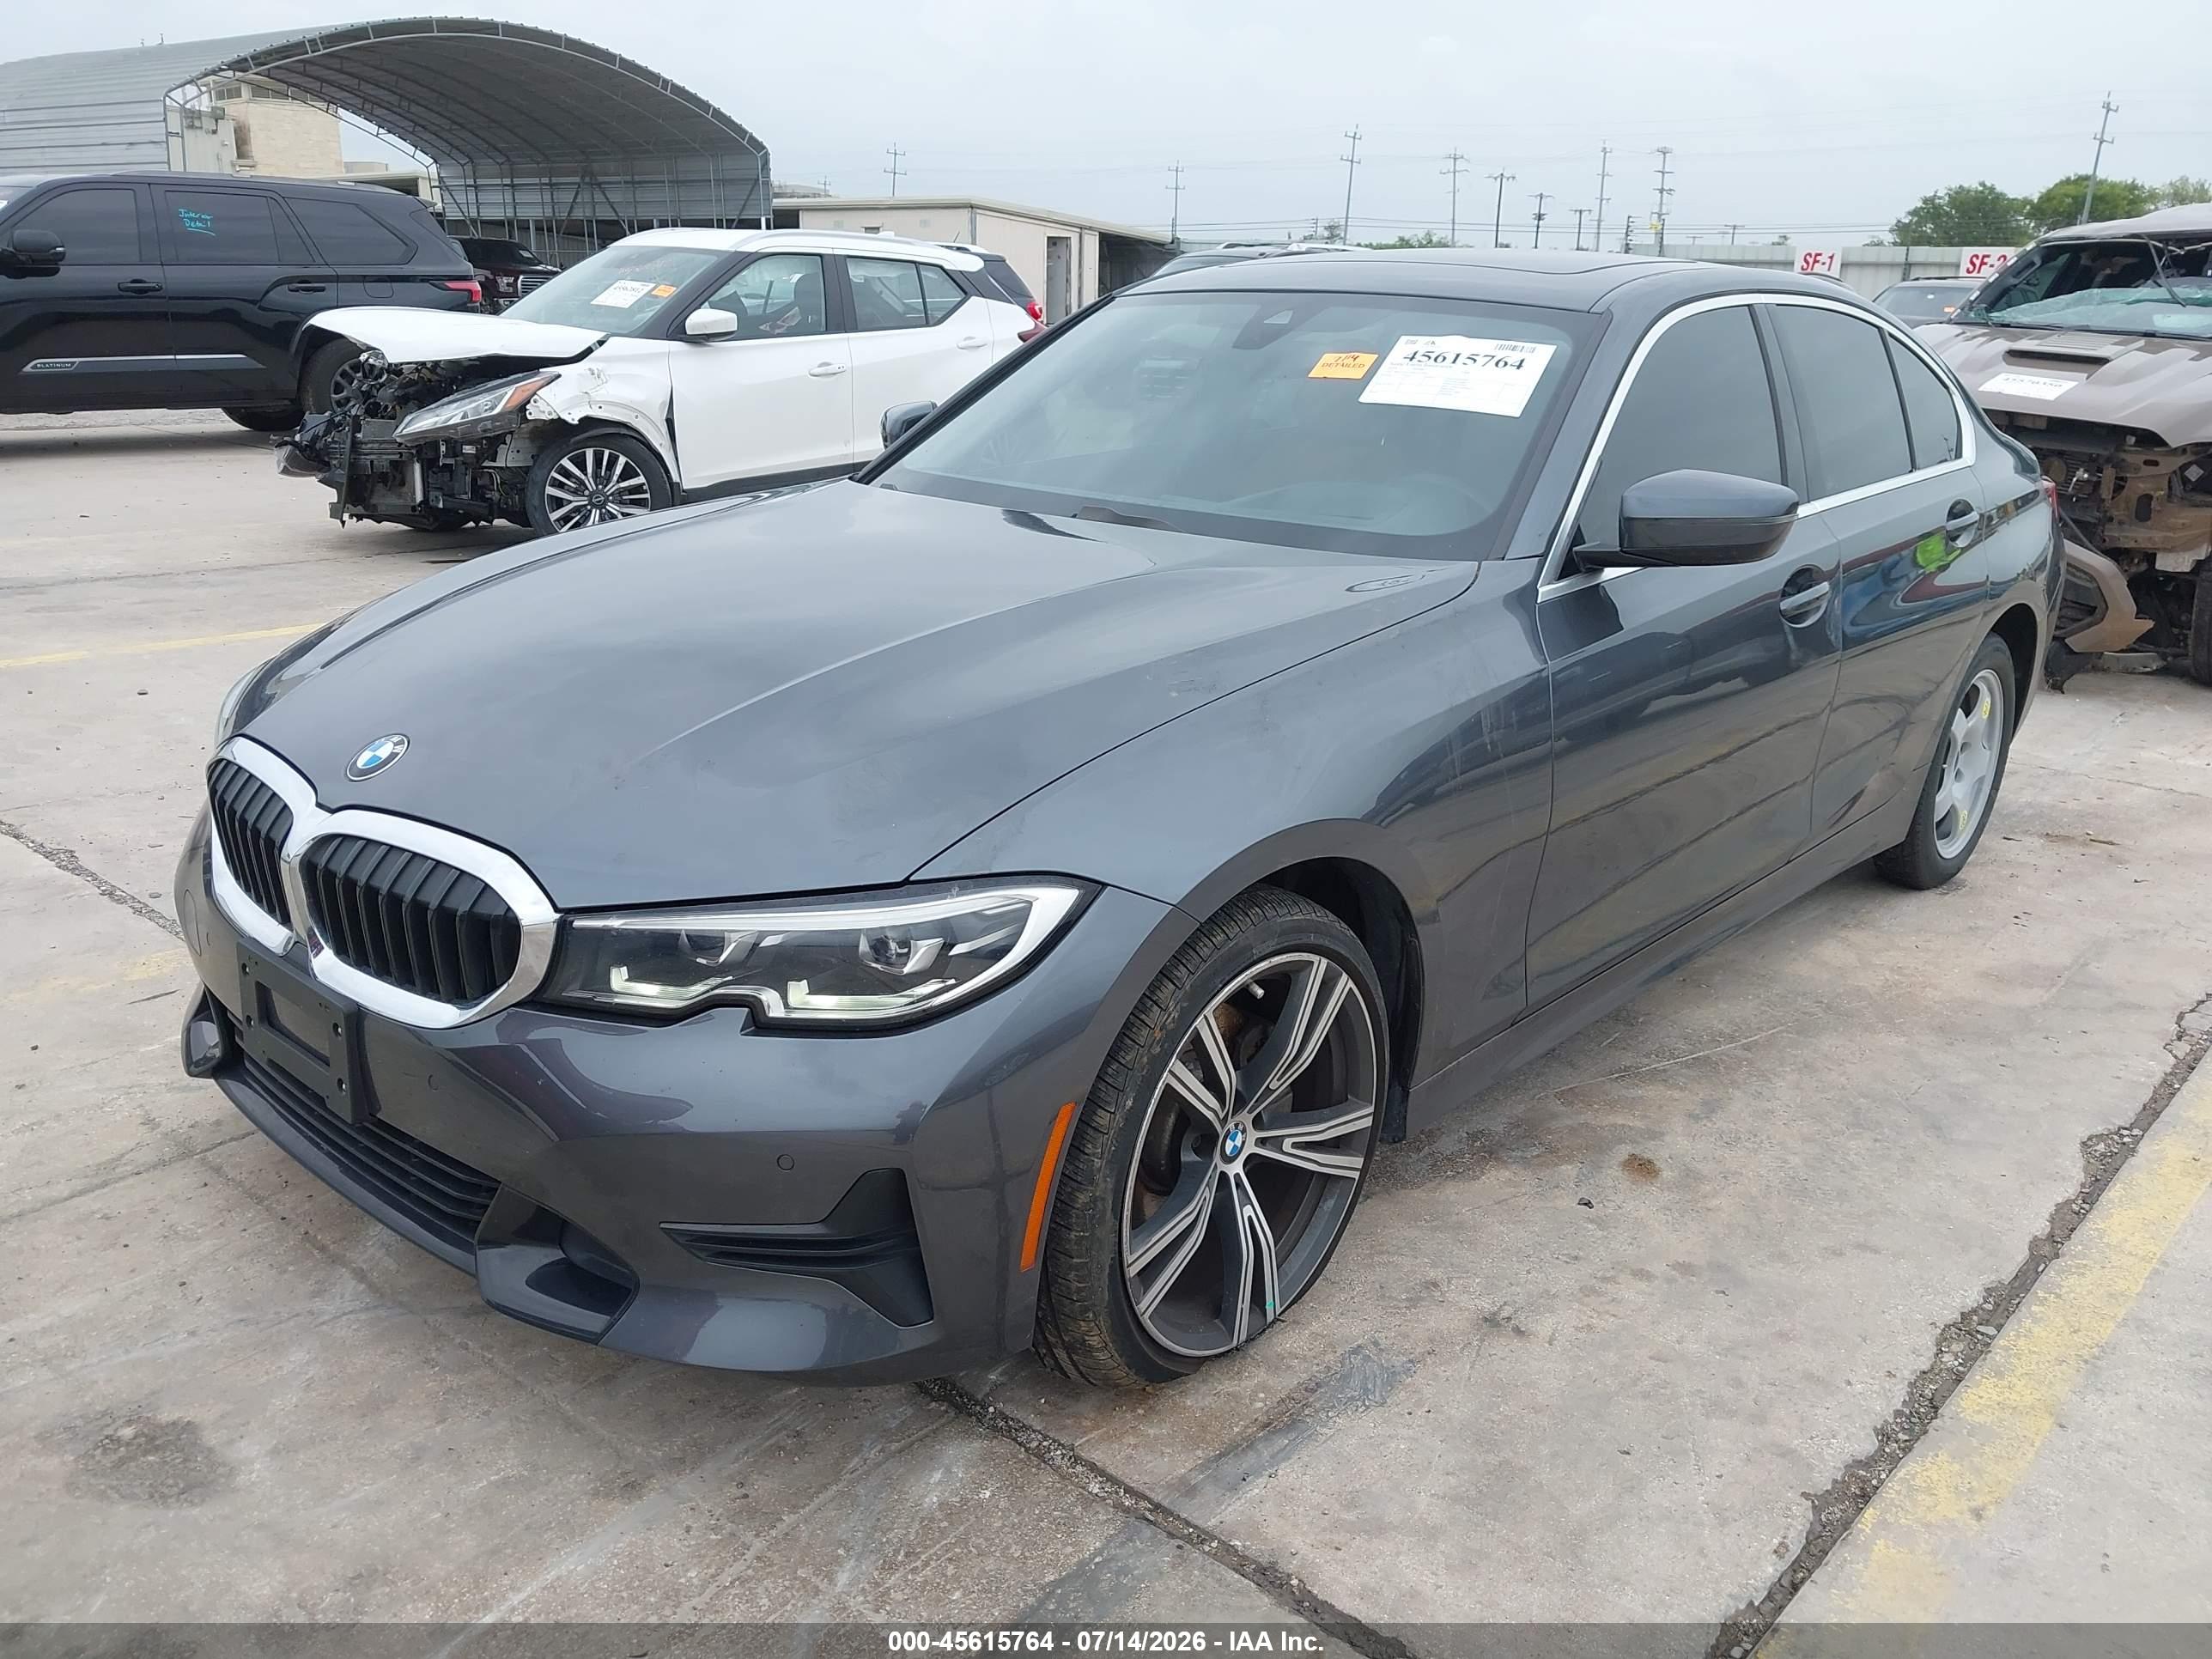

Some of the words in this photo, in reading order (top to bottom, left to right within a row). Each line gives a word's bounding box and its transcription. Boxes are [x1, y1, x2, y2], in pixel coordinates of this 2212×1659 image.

[1801, 252, 1835, 271] SF-1
[1402, 349, 1526, 371] 45615764
[1229, 1123, 1246, 1141] BMW
